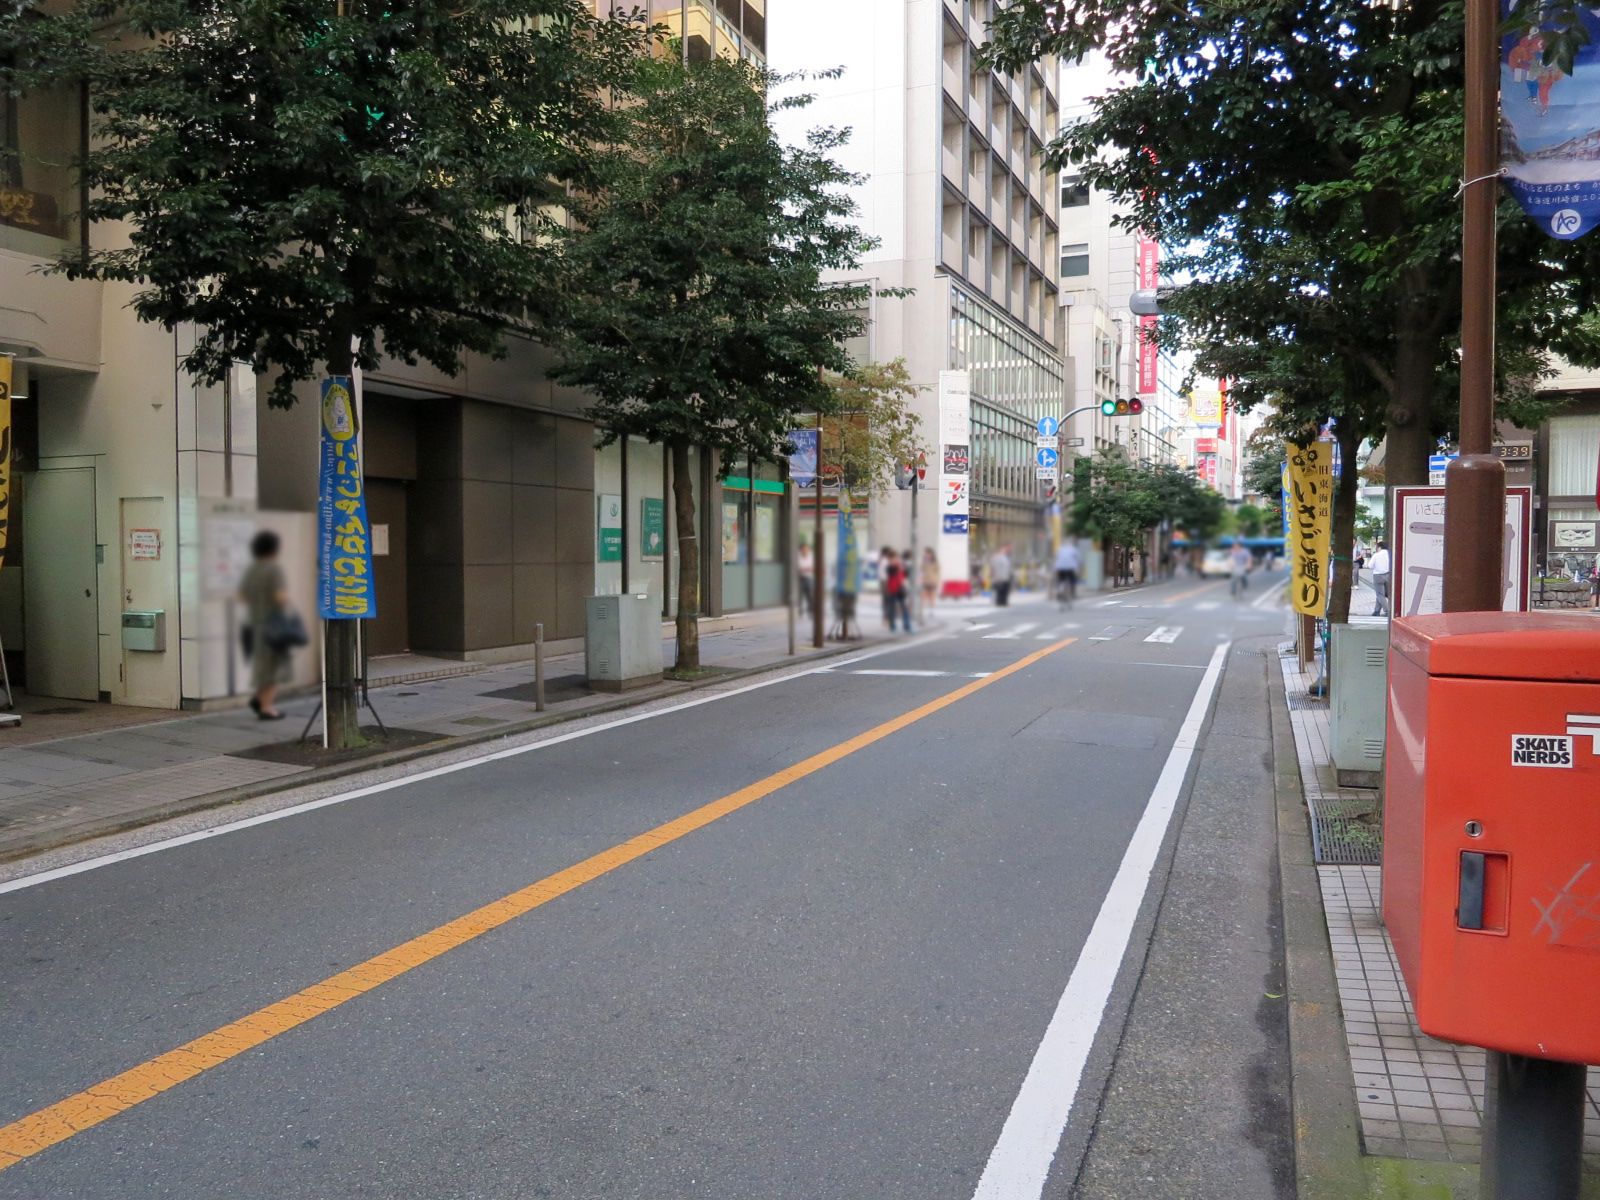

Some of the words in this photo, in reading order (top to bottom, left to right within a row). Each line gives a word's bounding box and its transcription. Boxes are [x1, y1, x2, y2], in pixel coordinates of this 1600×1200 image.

[1500, 446, 1528, 457] 3:39
[1318, 465, 1329, 517] 旧東海道
[1293, 479, 1322, 609] いさご通り
[1515, 737, 1567, 752] SKATE
[1513, 751, 1571, 765] NERDS
